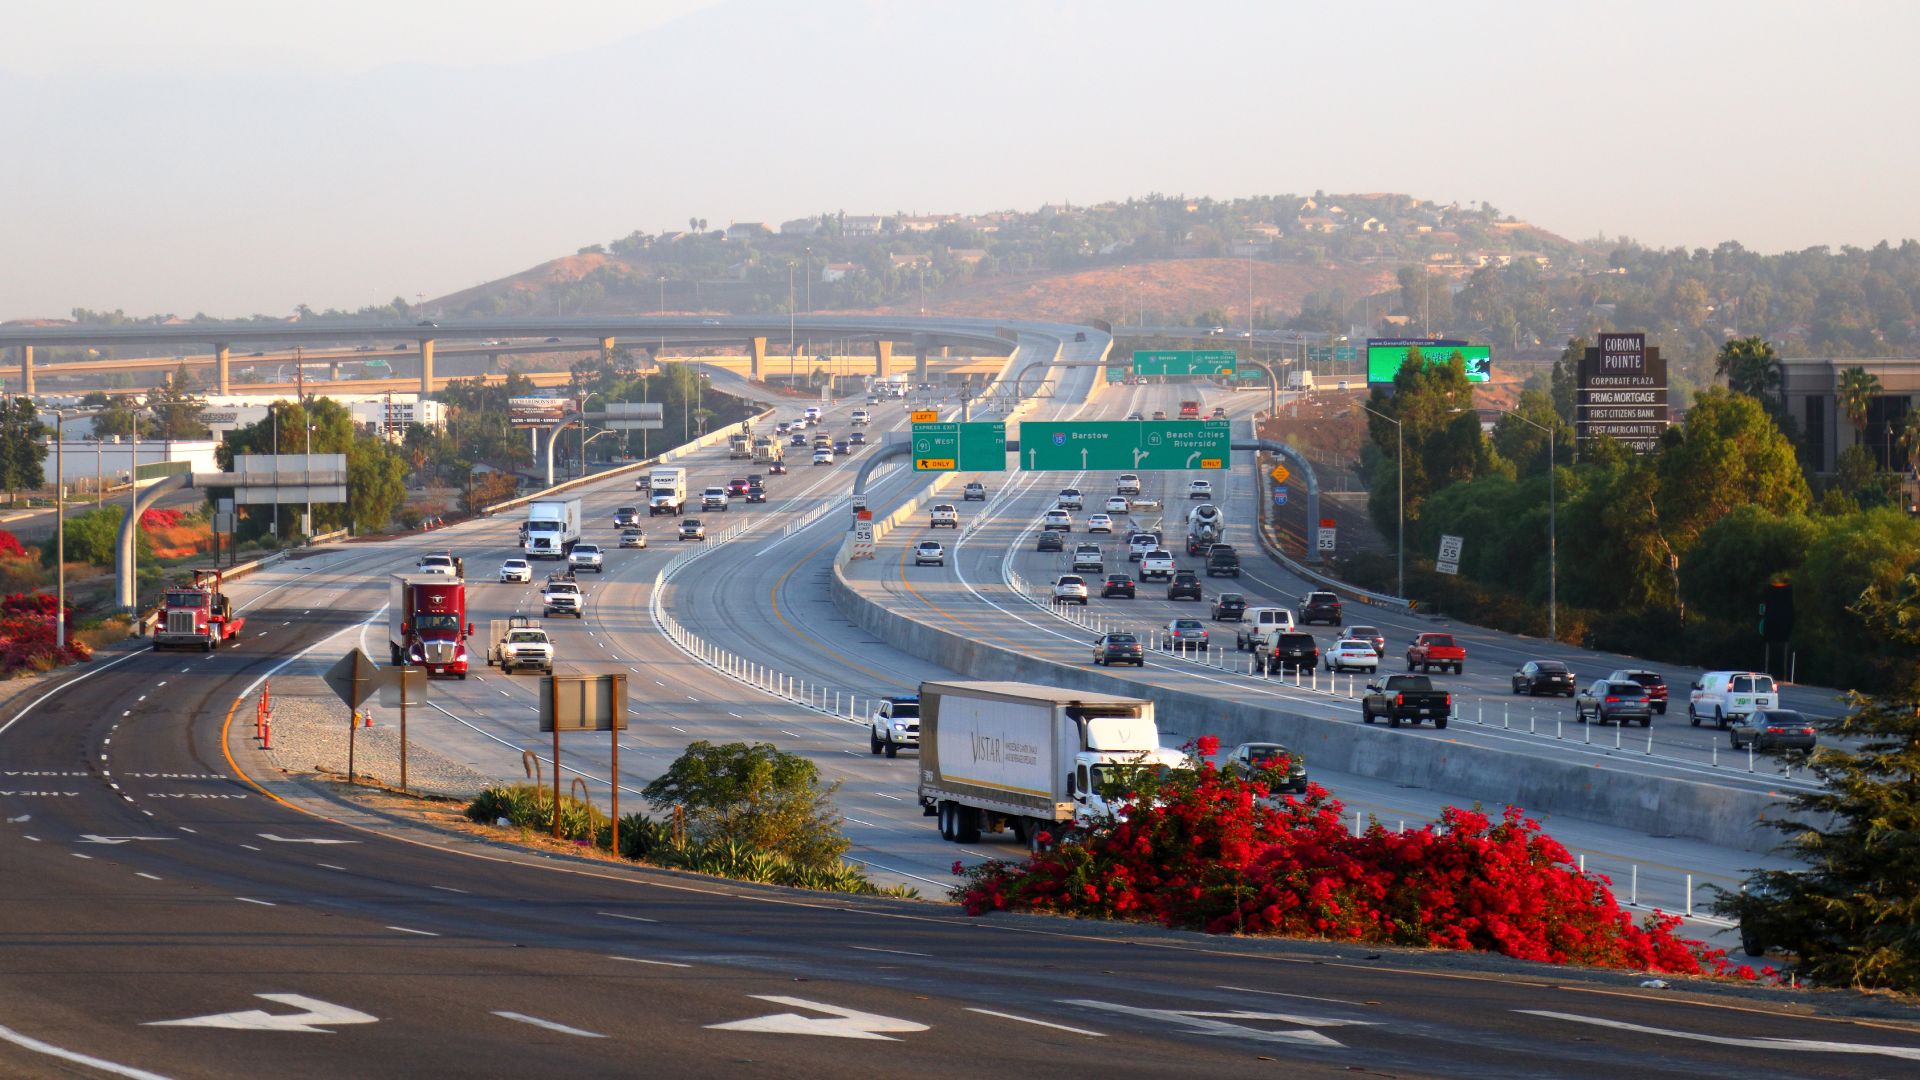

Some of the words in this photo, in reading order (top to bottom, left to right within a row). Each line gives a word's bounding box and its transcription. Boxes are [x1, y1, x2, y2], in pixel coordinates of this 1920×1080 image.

[1605, 338, 1641, 351] CORONA
[1605, 355, 1641, 369] POINTE
[1591, 377, 1630, 385] CORPORATE
[1632, 377, 1654, 385] PLAZA
[1590, 392, 1612, 402] PRMG
[1614, 392, 1656, 402] MORTGAGE
[1590, 409, 1608, 418] FIRST
[1608, 409, 1636, 418] CITIZENS
[1637, 409, 1655, 418] BANK
[1588, 426, 1606, 434] FIRST
[1607, 426, 1638, 434] AMERICAN
[1639, 426, 1656, 434] TITLE
[857, 532, 871, 540] 55
[1320, 540, 1334, 548] 55
[1442, 548, 1457, 558] 55
[970, 726, 1001, 764] VISTAR
